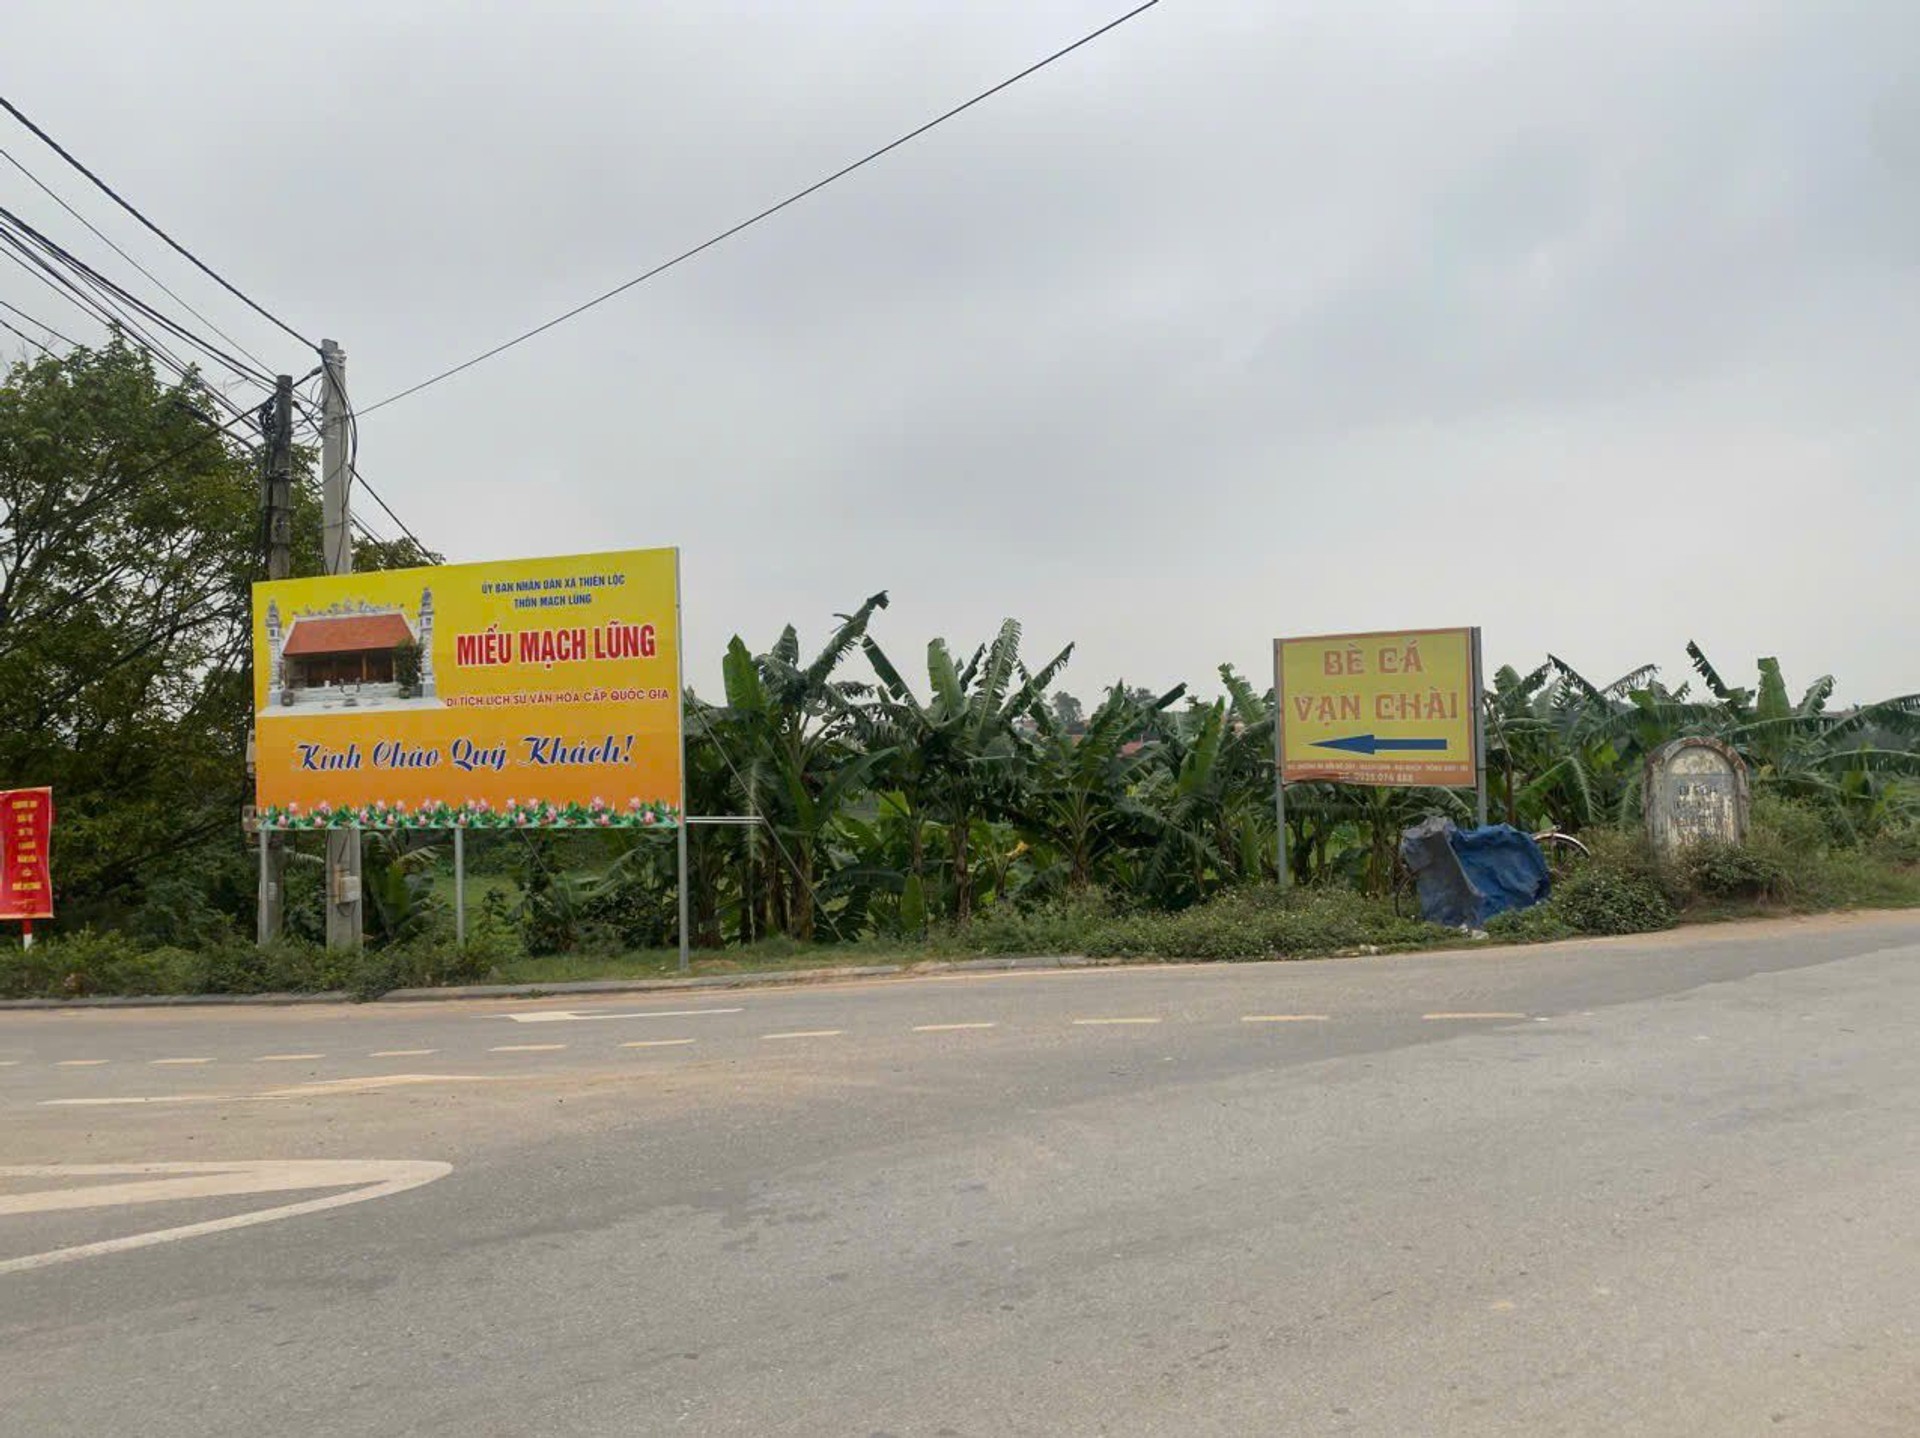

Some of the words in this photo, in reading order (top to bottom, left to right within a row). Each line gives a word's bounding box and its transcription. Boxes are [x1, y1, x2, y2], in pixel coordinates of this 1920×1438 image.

[495, 582, 513, 593] BAN
[457, 623, 512, 666] MIẾU
[519, 629, 586, 669] MẠCH
[594, 620, 656, 659] LŨNG
[1378, 639, 1423, 674] CÁ
[648, 688, 669, 700] GIA
[1294, 693, 1362, 728] VẠN
[1374, 686, 1458, 720] CHÀI
[452, 738, 507, 772] Quý
[524, 735, 634, 765] Khách!
